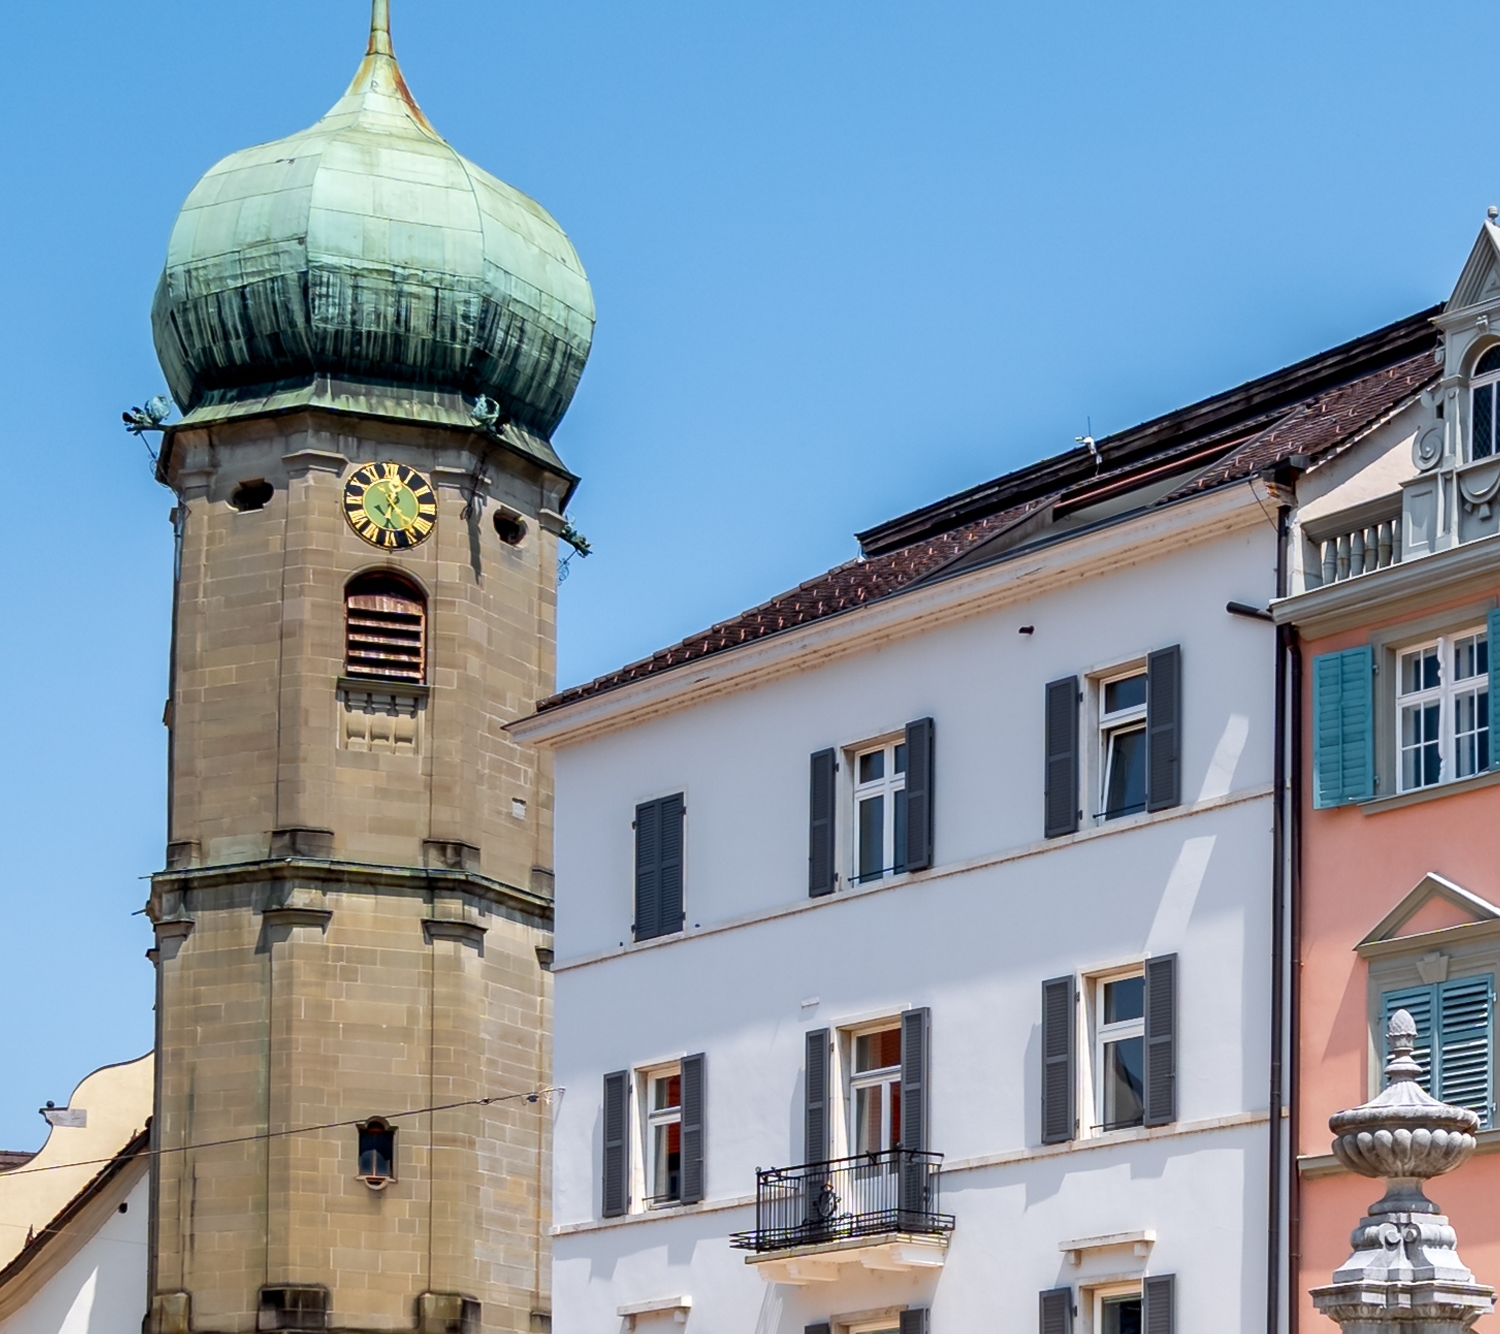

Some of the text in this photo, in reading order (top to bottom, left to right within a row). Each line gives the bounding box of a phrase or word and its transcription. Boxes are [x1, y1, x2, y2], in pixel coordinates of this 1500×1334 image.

[403, 470, 415, 485] I
[414, 484, 431, 498] II
[419, 503, 436, 515] III
